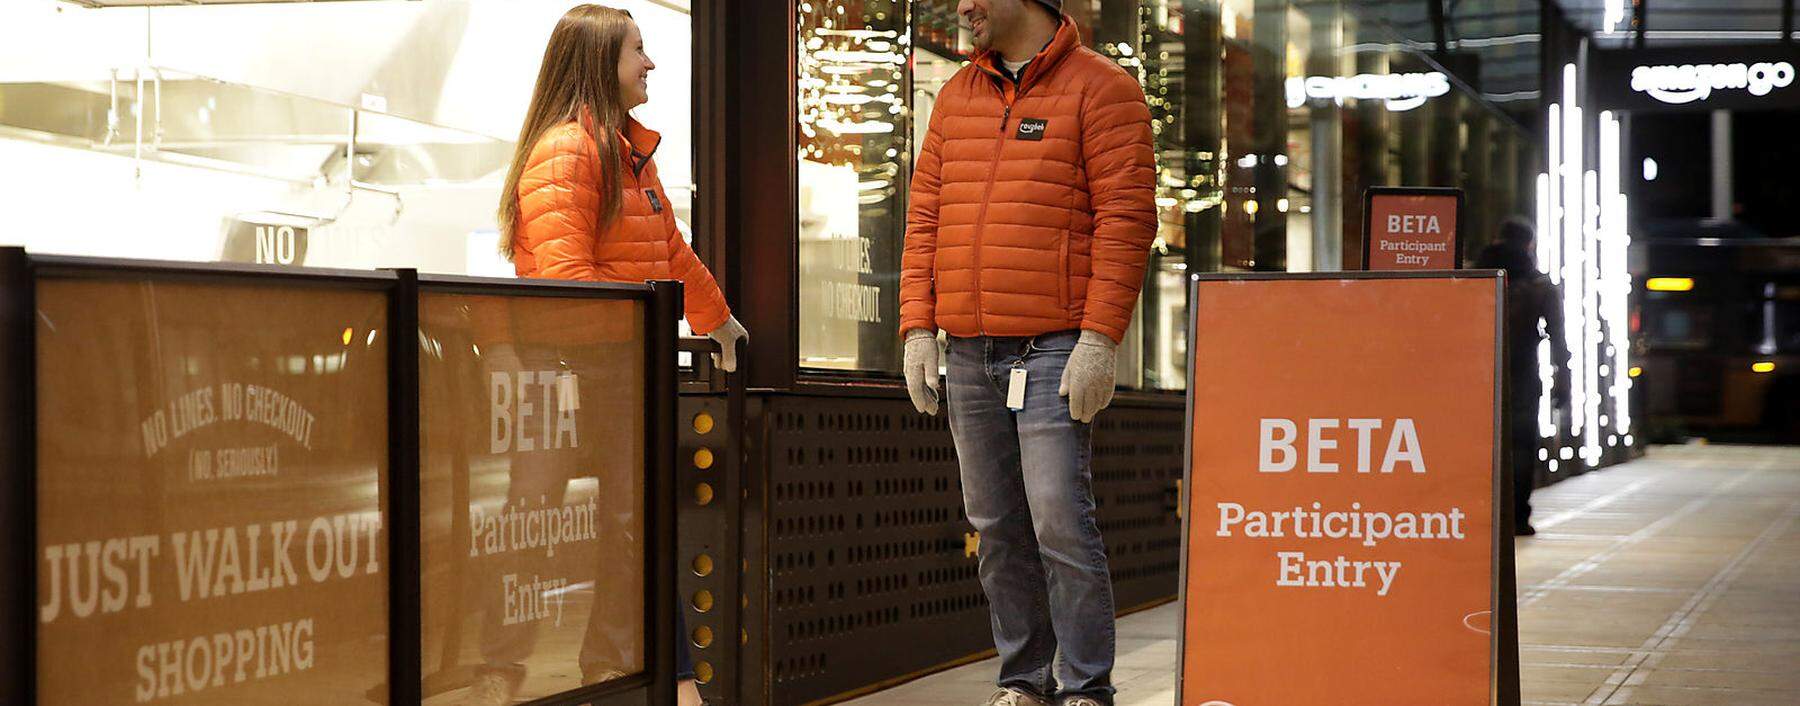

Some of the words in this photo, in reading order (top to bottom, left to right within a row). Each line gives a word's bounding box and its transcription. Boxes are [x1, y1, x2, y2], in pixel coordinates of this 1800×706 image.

[1748, 61, 1796, 96] go
[255, 226, 295, 265] NO
[1380, 240, 1446, 253] Participant
[1387, 214, 1440, 233] BETA
[1396, 253, 1429, 266] Entry
[142, 409, 168, 459] NO
[222, 383, 242, 421] NO
[490, 370, 579, 454] BETA
[1258, 418, 1426, 473] BETA
[470, 496, 598, 557] Participant
[1216, 502, 1465, 546] Participant
[41, 534, 159, 623] JUST
[172, 520, 297, 602] WALK
[306, 511, 382, 583] OUT
[1276, 551, 1401, 596] Entry
[502, 573, 567, 627] Entry
[136, 618, 314, 703] SHOPPING
